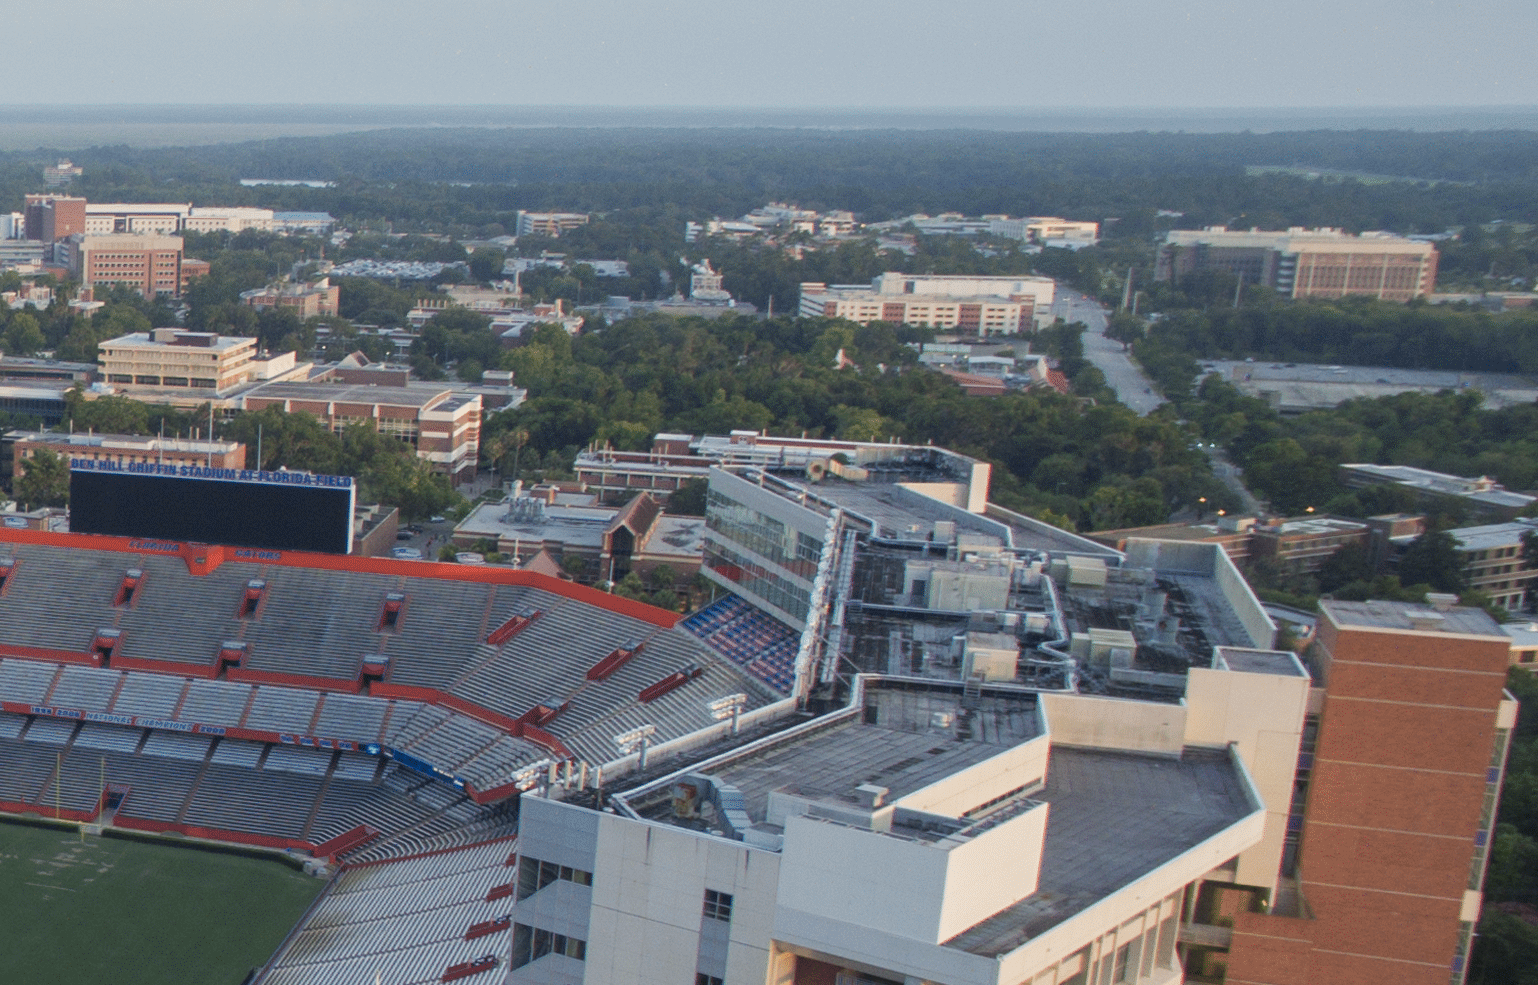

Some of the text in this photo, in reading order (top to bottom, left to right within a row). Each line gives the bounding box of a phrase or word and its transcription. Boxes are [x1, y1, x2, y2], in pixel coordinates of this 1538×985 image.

[71, 458, 352, 487] BEN HILL GRIFFIN STADIUM AT FLORIDA FIELD
